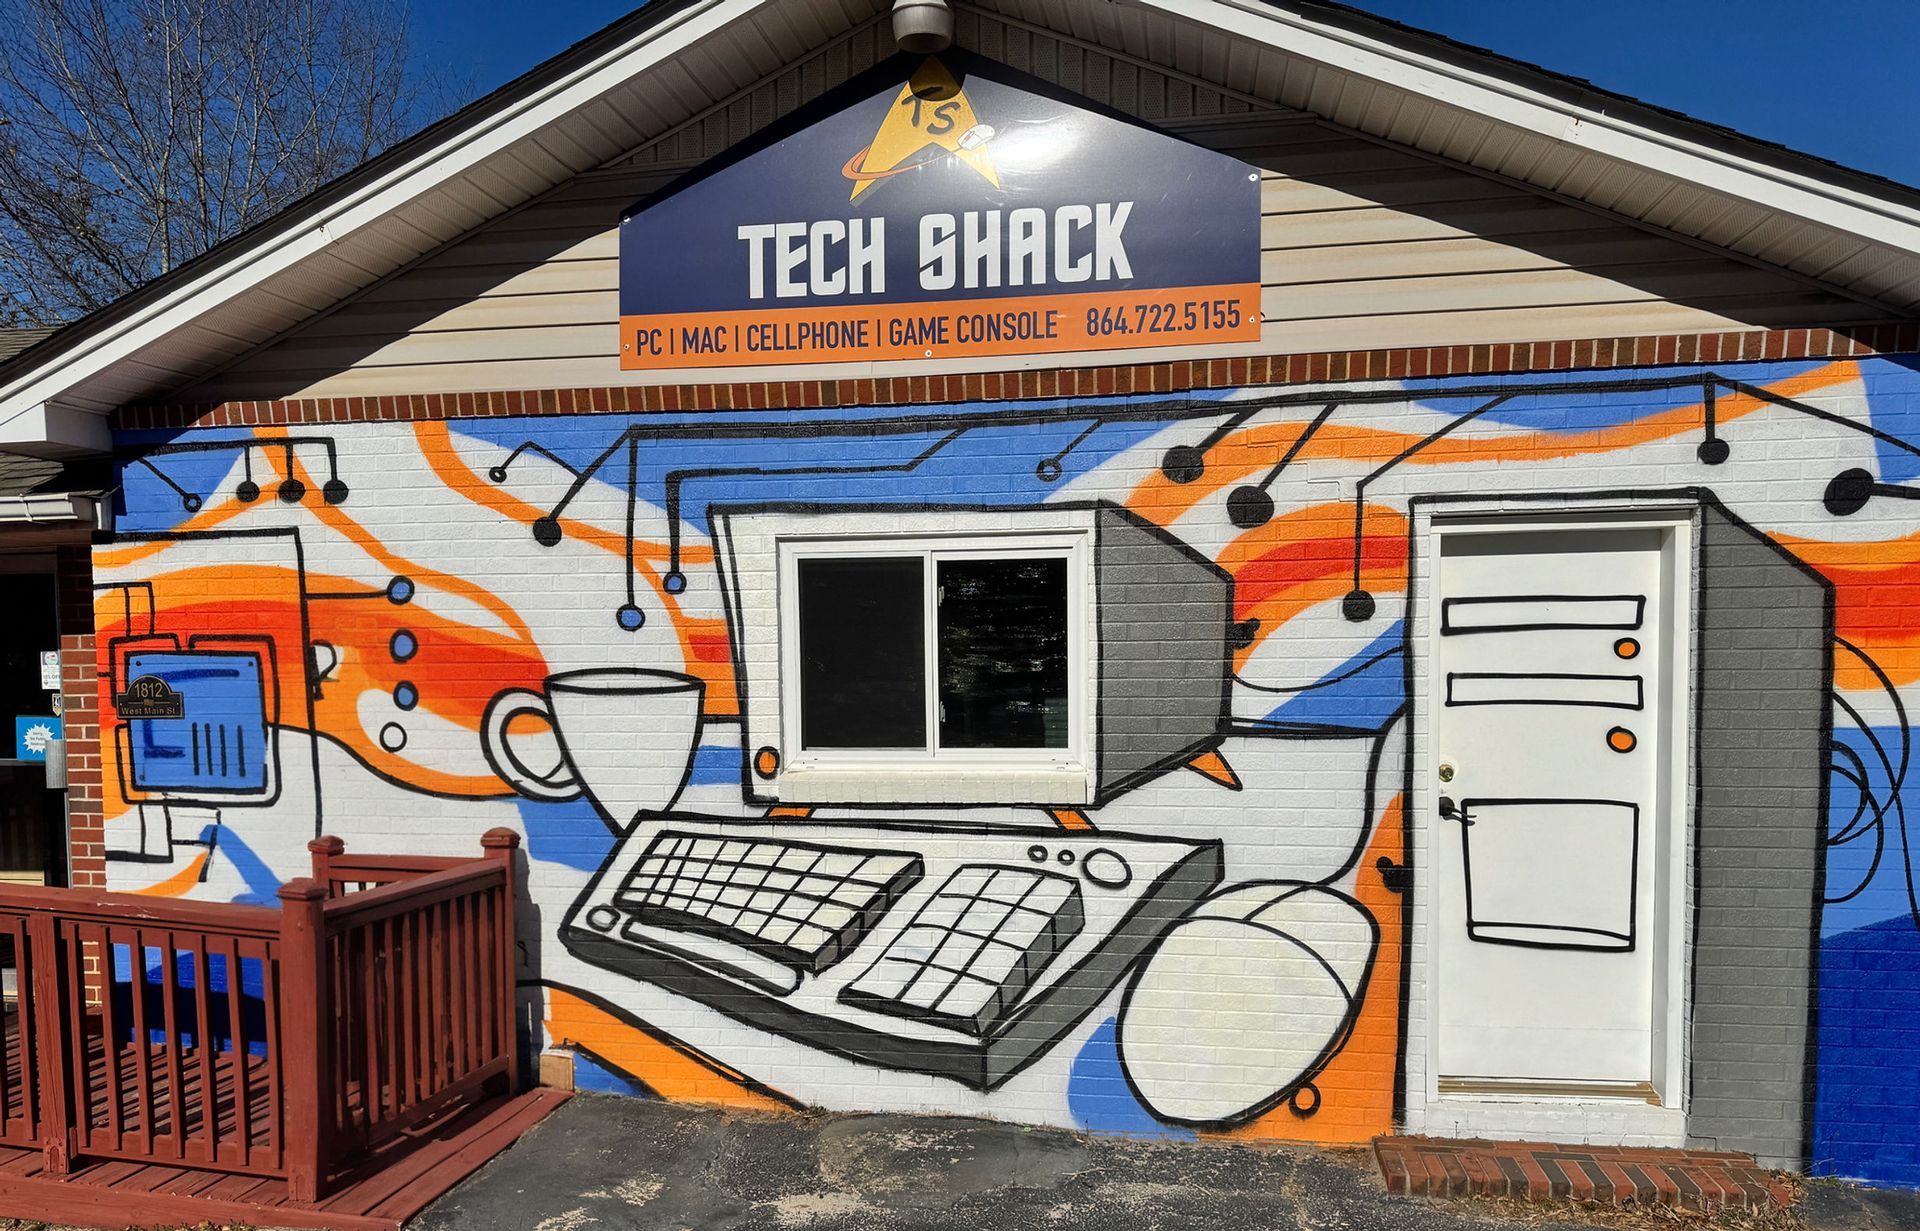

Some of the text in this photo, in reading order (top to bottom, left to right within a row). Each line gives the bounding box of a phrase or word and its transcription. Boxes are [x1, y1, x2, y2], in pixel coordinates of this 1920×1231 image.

[901, 86, 961, 135] TS
[737, 201, 1134, 299] TECH SHACK
[636, 299, 1241, 356] PC MAC CELLPHONE GAME CONSOLE 864.722.5155
[121, 707, 142, 715] West
[144, 707, 165, 715] Main
[134, 682, 163, 698] 1812
